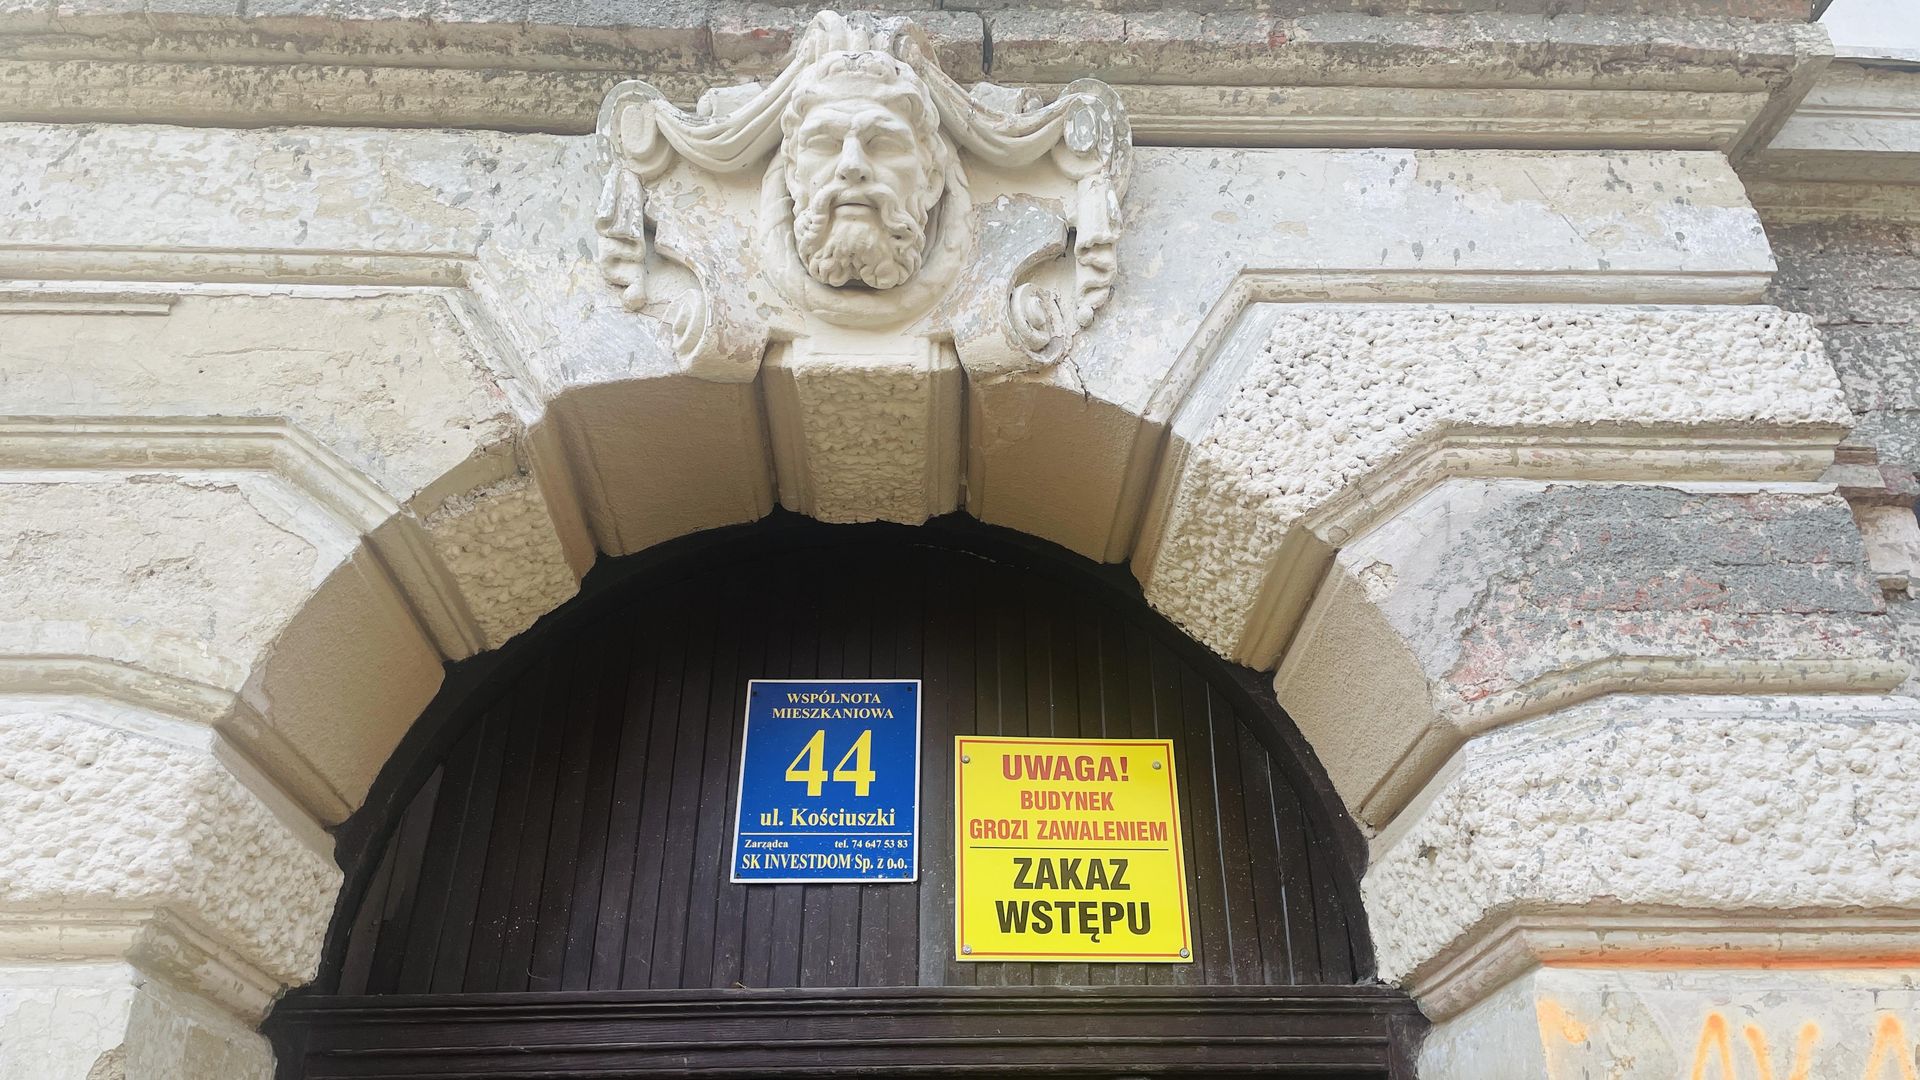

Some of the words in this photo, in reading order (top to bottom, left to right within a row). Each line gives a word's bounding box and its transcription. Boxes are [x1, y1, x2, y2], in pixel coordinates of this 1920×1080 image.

[787, 690, 881, 704] WSPÓLNOTA
[772, 708, 894, 719] MIESZKANIOWA
[785, 729, 876, 797] 44
[1002, 754, 1129, 782] UWAGA!
[1020, 790, 1114, 811] BUDYNEK
[760, 809, 784, 826] ul.
[791, 808, 896, 827] Kościuszki
[969, 818, 1028, 840] GROZI
[1036, 820, 1168, 842] ZAWALENIEM
[744, 839, 789, 850] Zarządca
[834, 839, 849, 848] tel.
[851, 840, 863, 848] 74
[865, 840, 882, 848] 647
[884, 840, 895, 848] 53
[897, 840, 908, 848] 83
[742, 854, 761, 870] SK
[764, 854, 851, 870] INVESTDOM
[854, 854, 873, 873] Sp.
[877, 858, 884, 870] z
[887, 858, 908, 870] o.o.
[1013, 857, 1131, 891] ZAKAZ
[995, 900, 1152, 944] WSTĘPU
